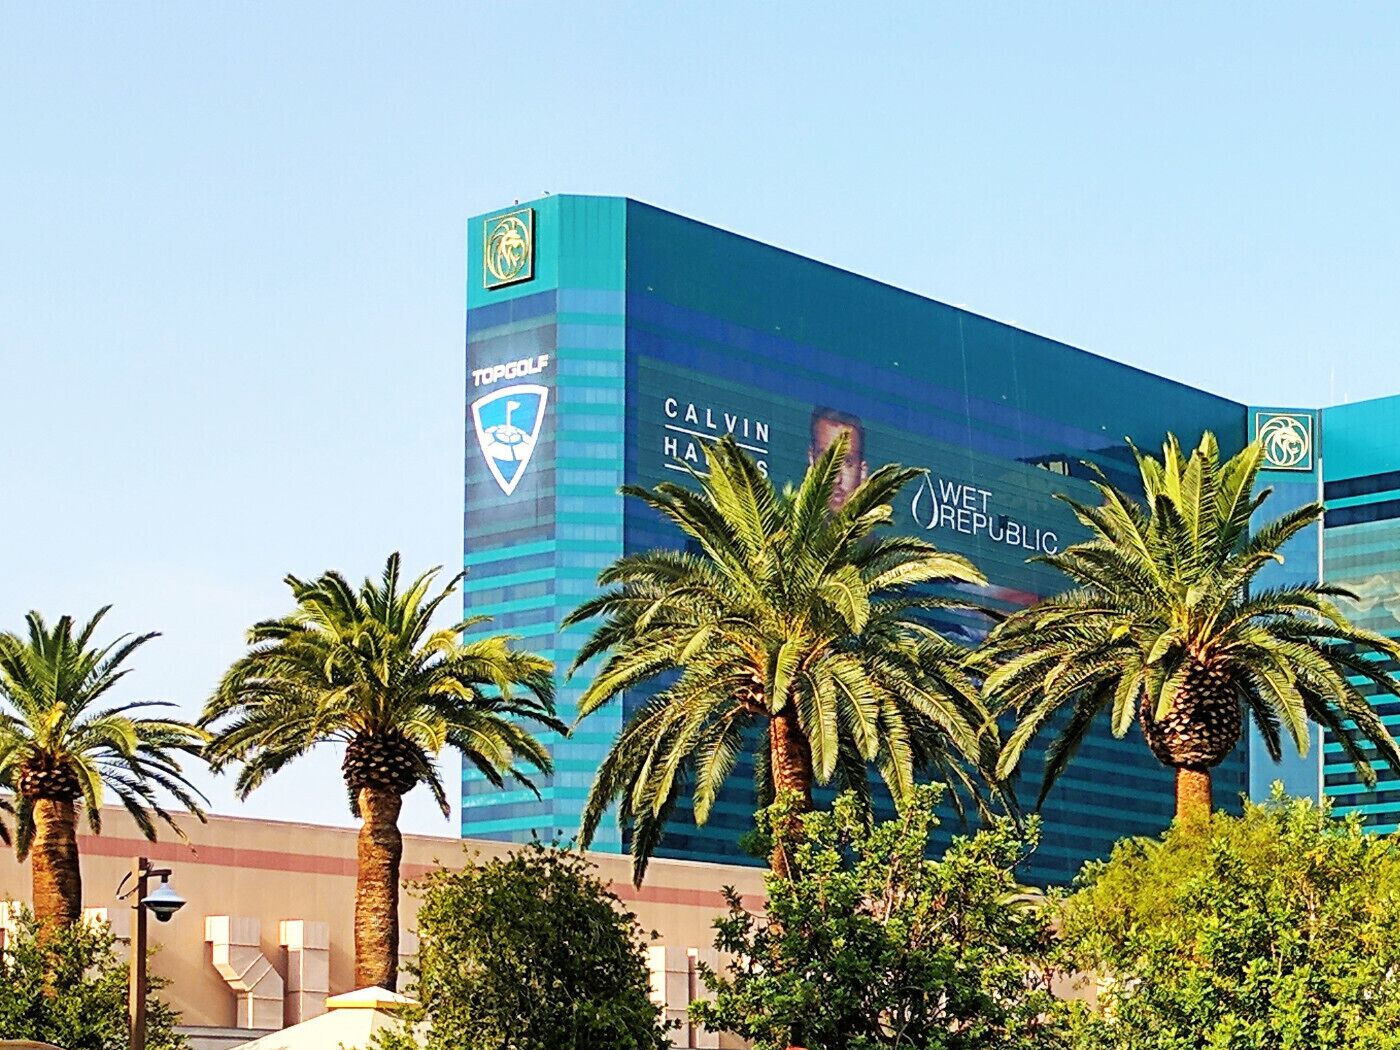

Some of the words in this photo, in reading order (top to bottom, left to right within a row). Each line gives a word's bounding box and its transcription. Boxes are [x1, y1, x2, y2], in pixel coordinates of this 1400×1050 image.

[472, 354, 549, 387] TOPGOLF
[664, 397, 769, 443] CALVIN
[664, 436, 769, 479] HAS
[939, 479, 993, 513] WET
[940, 504, 1058, 555] REPUBLIC
